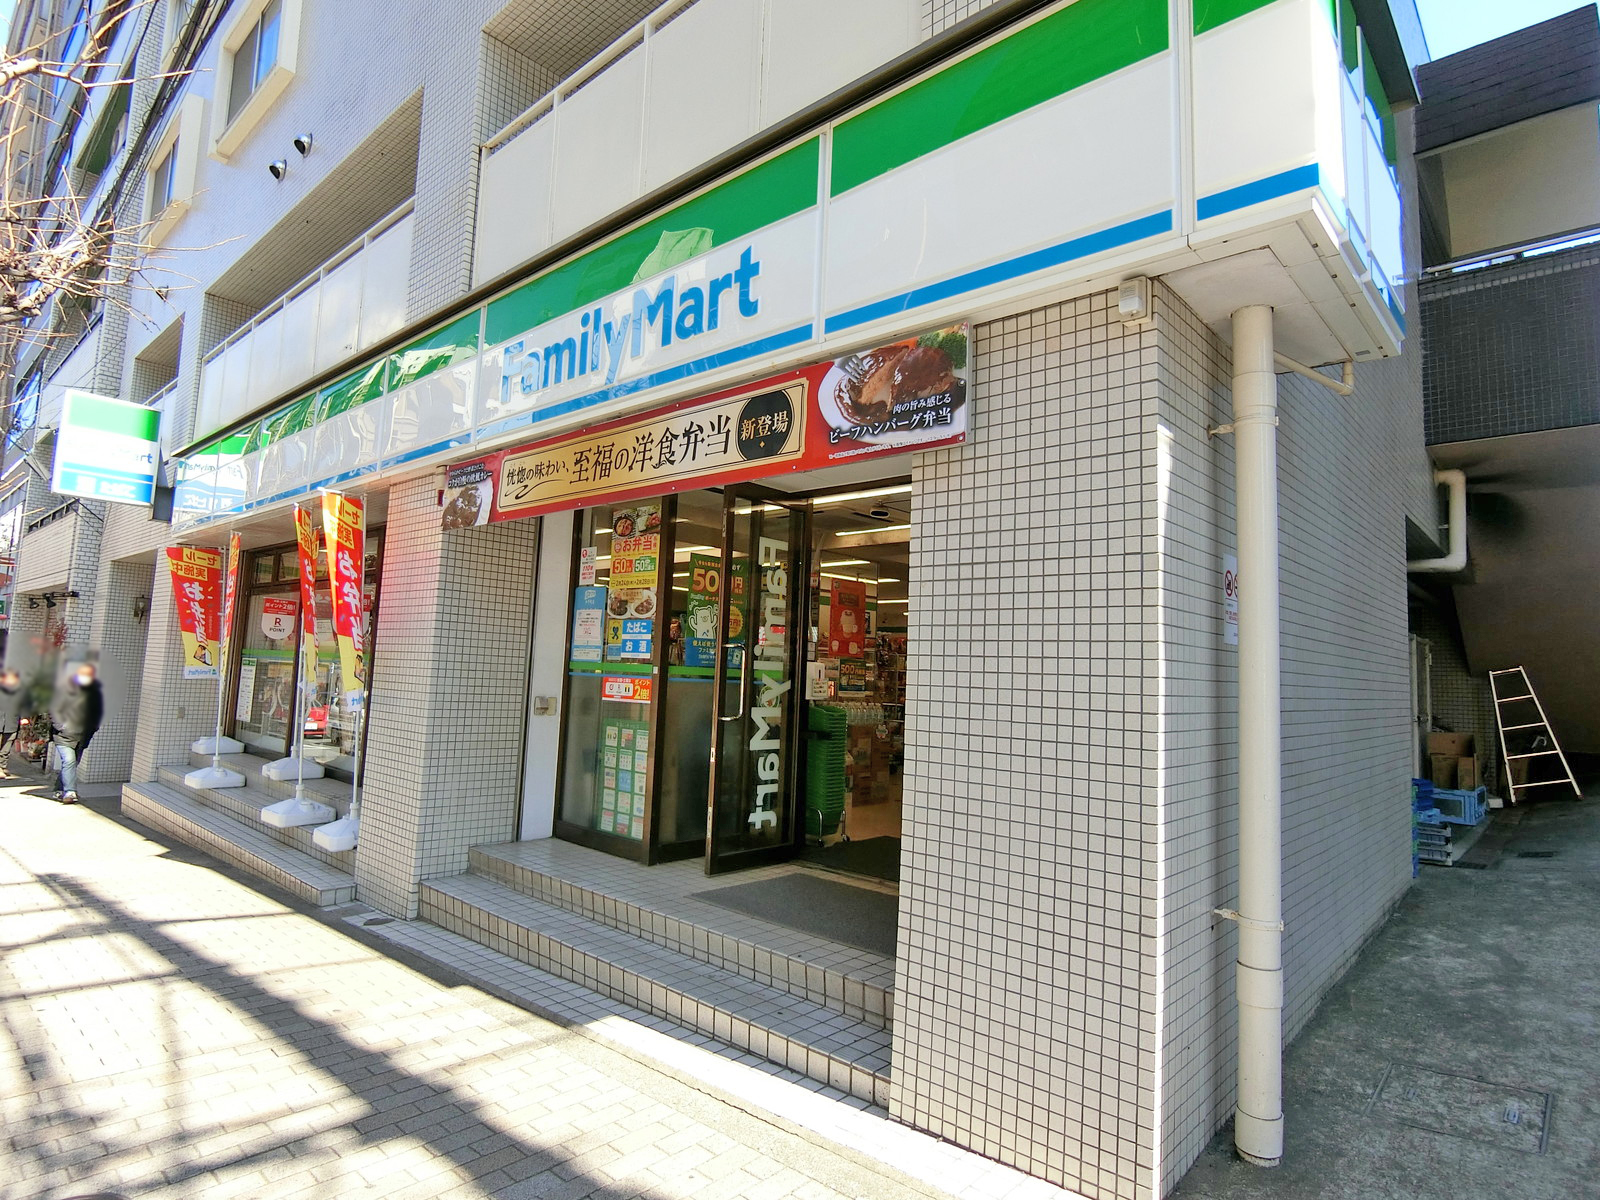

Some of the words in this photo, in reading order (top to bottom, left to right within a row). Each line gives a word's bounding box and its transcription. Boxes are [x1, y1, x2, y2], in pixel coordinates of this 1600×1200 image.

[500, 246, 761, 403] FamilyMart
[893, 393, 952, 414] 肉の旨み感じる
[740, 410, 789, 441] 新登場
[829, 407, 952, 444] ビーフハンバーグ弁当
[569, 414, 732, 485] 至福の洋食弁当
[623, 535, 652, 553] お弁当
[274, 617, 282, 626] R
[626, 622, 647, 633] たばこ
